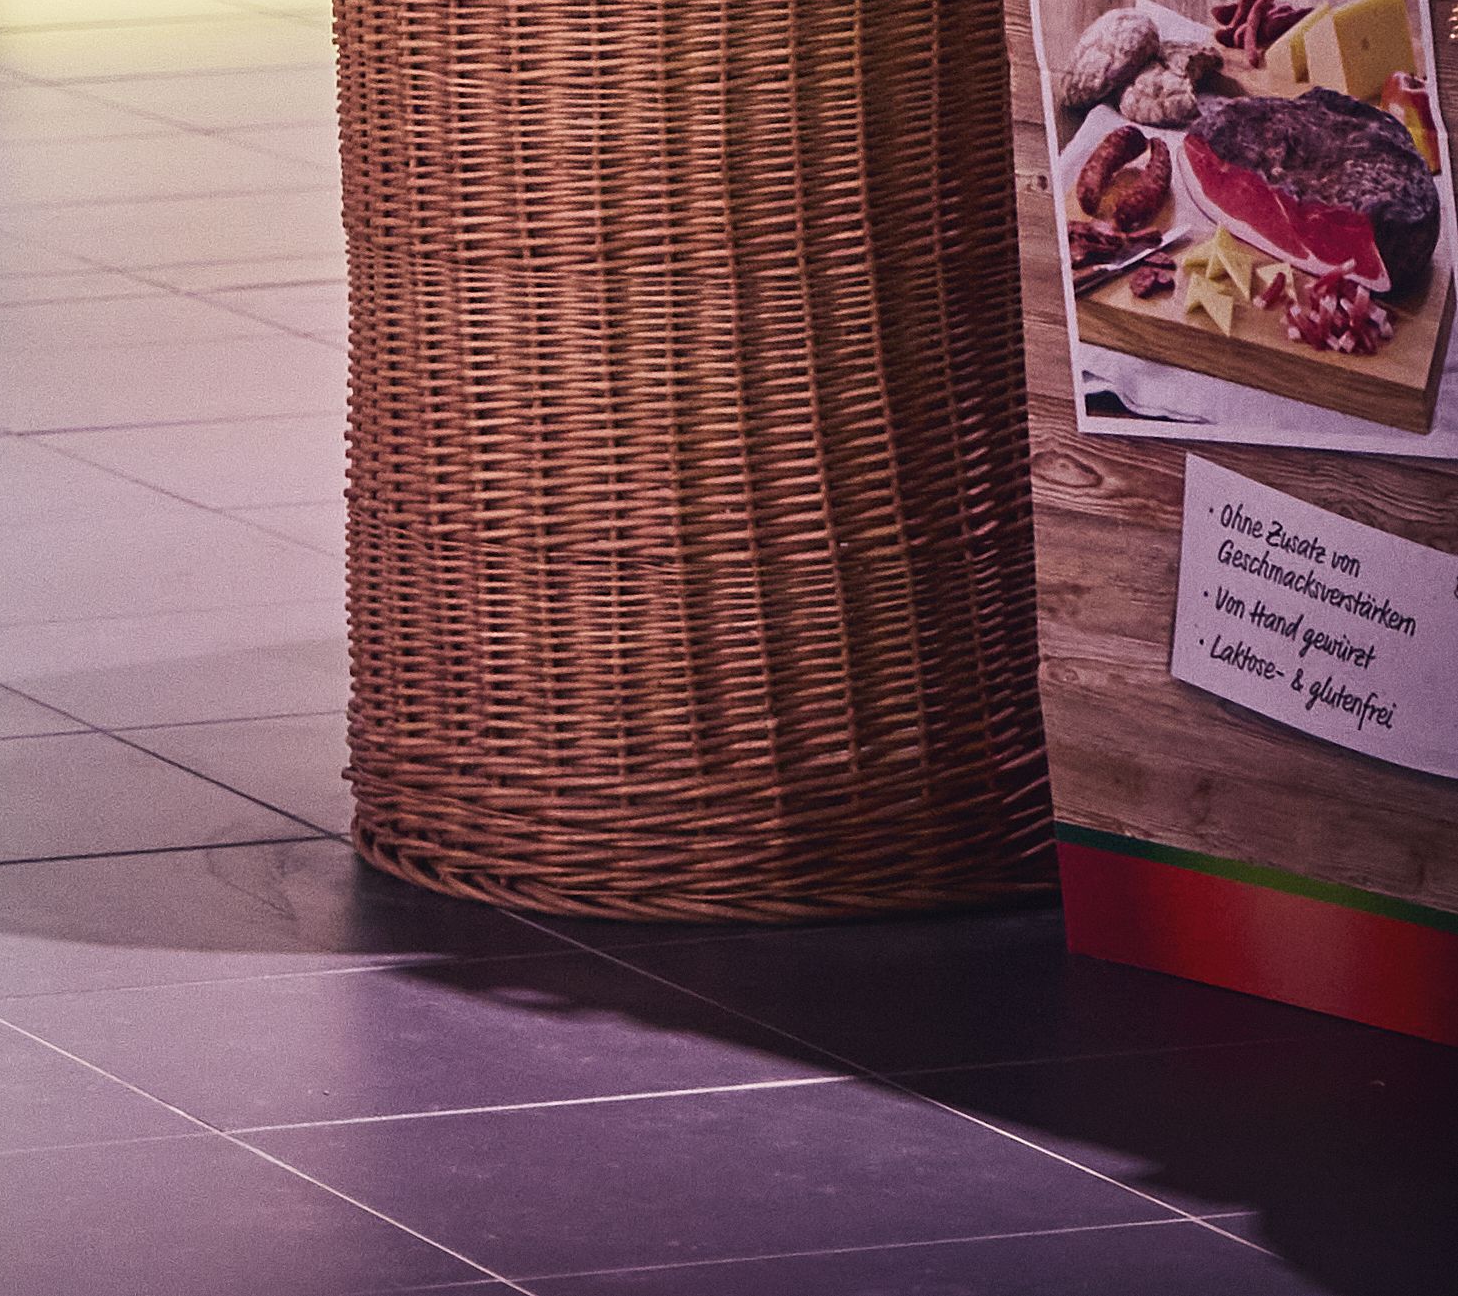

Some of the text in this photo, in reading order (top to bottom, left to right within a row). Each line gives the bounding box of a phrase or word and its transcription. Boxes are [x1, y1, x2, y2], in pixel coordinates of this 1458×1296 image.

[1220, 503, 1361, 578] Ohne Zusatz von
[1215, 586, 1377, 669] Von Hand gewürzt
[1218, 539, 1417, 637] Geschmacksverstärkern
[1210, 635, 1395, 730] Laktose- & glutenfrei
